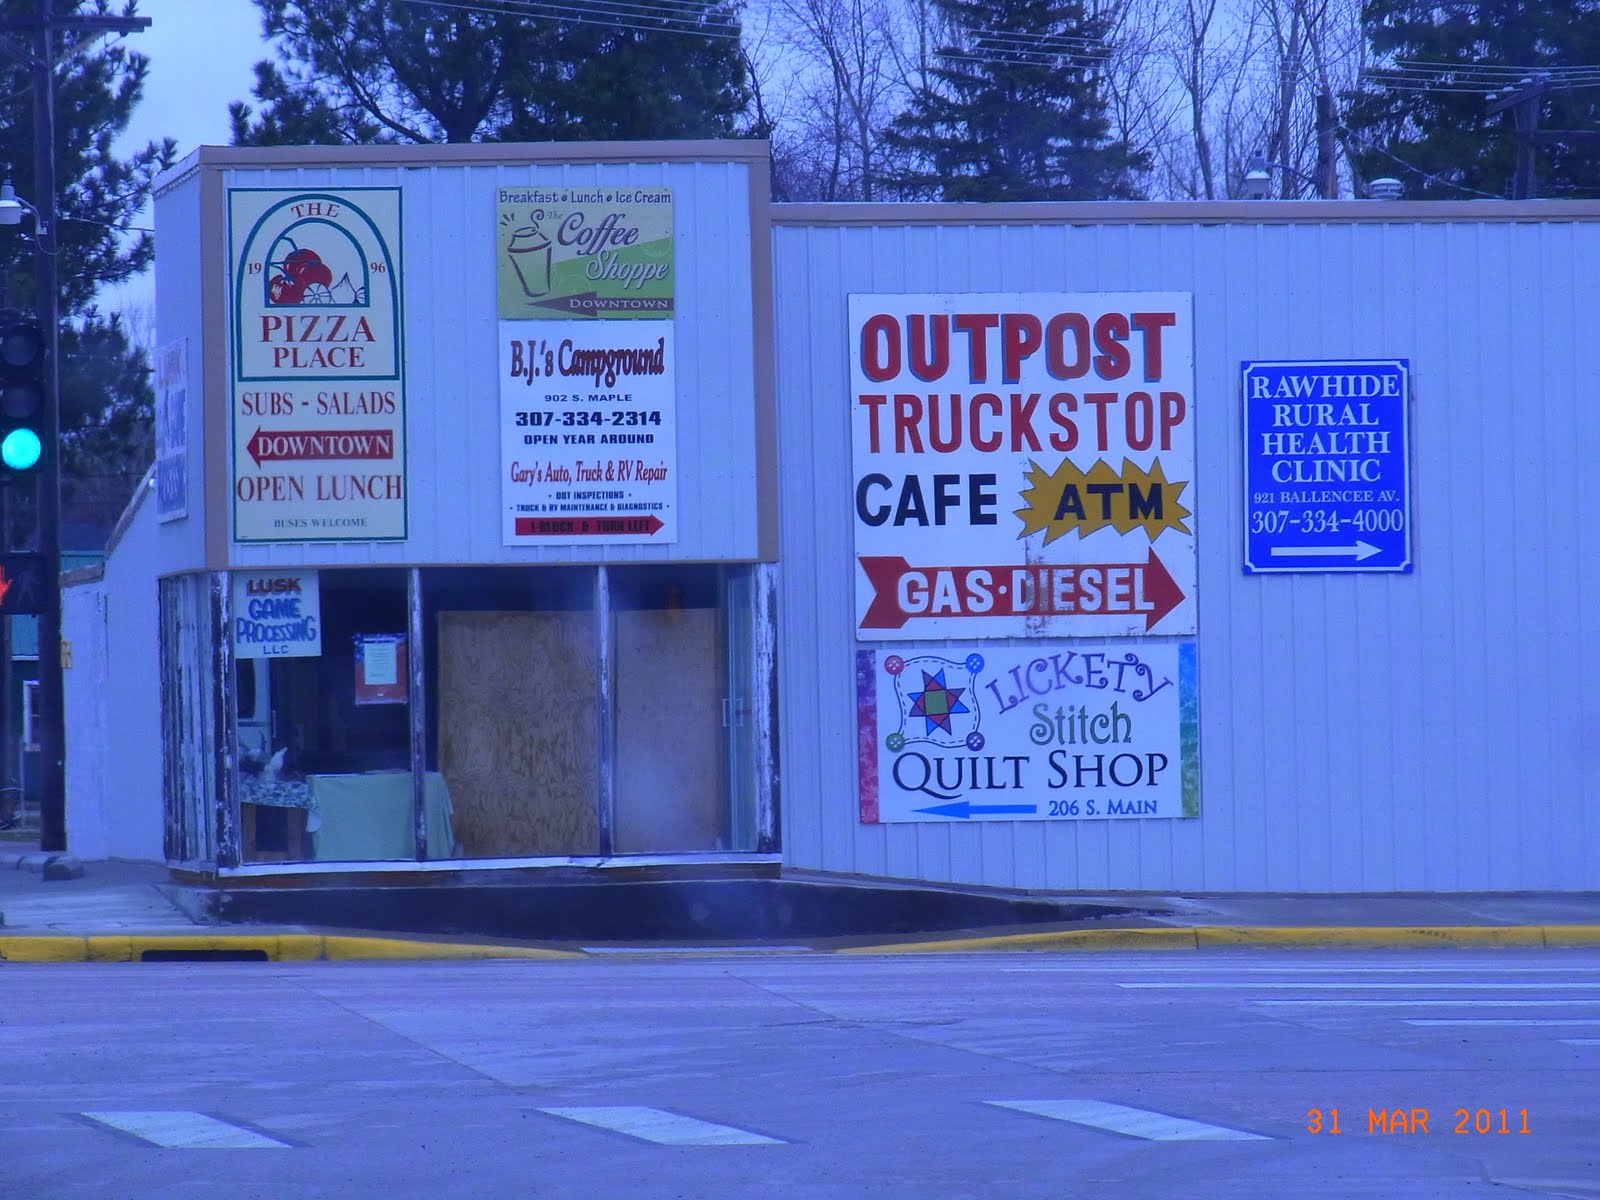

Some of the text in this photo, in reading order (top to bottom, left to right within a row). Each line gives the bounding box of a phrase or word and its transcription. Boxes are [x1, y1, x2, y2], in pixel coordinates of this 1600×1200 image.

[500, 190, 671, 204] Breakfast Lunch Ice Cream
[290, 202, 340, 218] THE
[547, 210, 564, 220] The
[557, 211, 640, 256] Coffee
[247, 262, 386, 274] 19 96
[586, 250, 668, 290] Shoppe
[570, 299, 668, 309] DOWNTOWN
[259, 315, 376, 342] PIZZA
[272, 347, 365, 368] PLACE
[860, 312, 1176, 384] OUTPOST
[510, 336, 665, 388] B.J.'s Campground
[544, 394, 632, 402] 902 S. MAPLE
[1251, 374, 1400, 399] RAWHIDE
[242, 392, 294, 416] SUBS
[316, 391, 396, 415] SALADS
[1272, 403, 1380, 428] RURAL
[515, 411, 662, 427] 307-334-2314
[858, 392, 1186, 454] TRUCKSTOP
[258, 435, 390, 456] DOWNTOWN
[524, 434, 654, 445] OPEN YEAR AROUND
[1261, 432, 1391, 456] HEALTH
[511, 460, 668, 487] Gary's Auto, Truck & RV Repair
[1272, 459, 1381, 483] CLINIC
[236, 474, 402, 502] OPEN LUNCH
[556, 491, 624, 500] DOT INSPECTIONS
[856, 473, 1163, 527] CAFE ATM
[1254, 490, 1400, 504] 921 BALLENCEE AV.
[516, 504, 540, 512] TRUCK
[550, 504, 558, 512] RV
[560, 503, 608, 512] MAINTENANCE
[618, 502, 663, 510] DIAGNOSTICS
[274, 518, 368, 528] BUSES WELCOME
[1251, 509, 1404, 534] 307-334-4000
[246, 578, 302, 597] LUSK
[248, 598, 302, 620] GAME
[236, 616, 317, 644] PROCESSING
[263, 645, 289, 655] LLC
[985, 651, 1174, 715] LICKETY
[1029, 700, 1132, 746] Stitch
[892, 749, 1168, 800] QUILT SHOP
[1048, 800, 1158, 816] 206 S. MAIN
